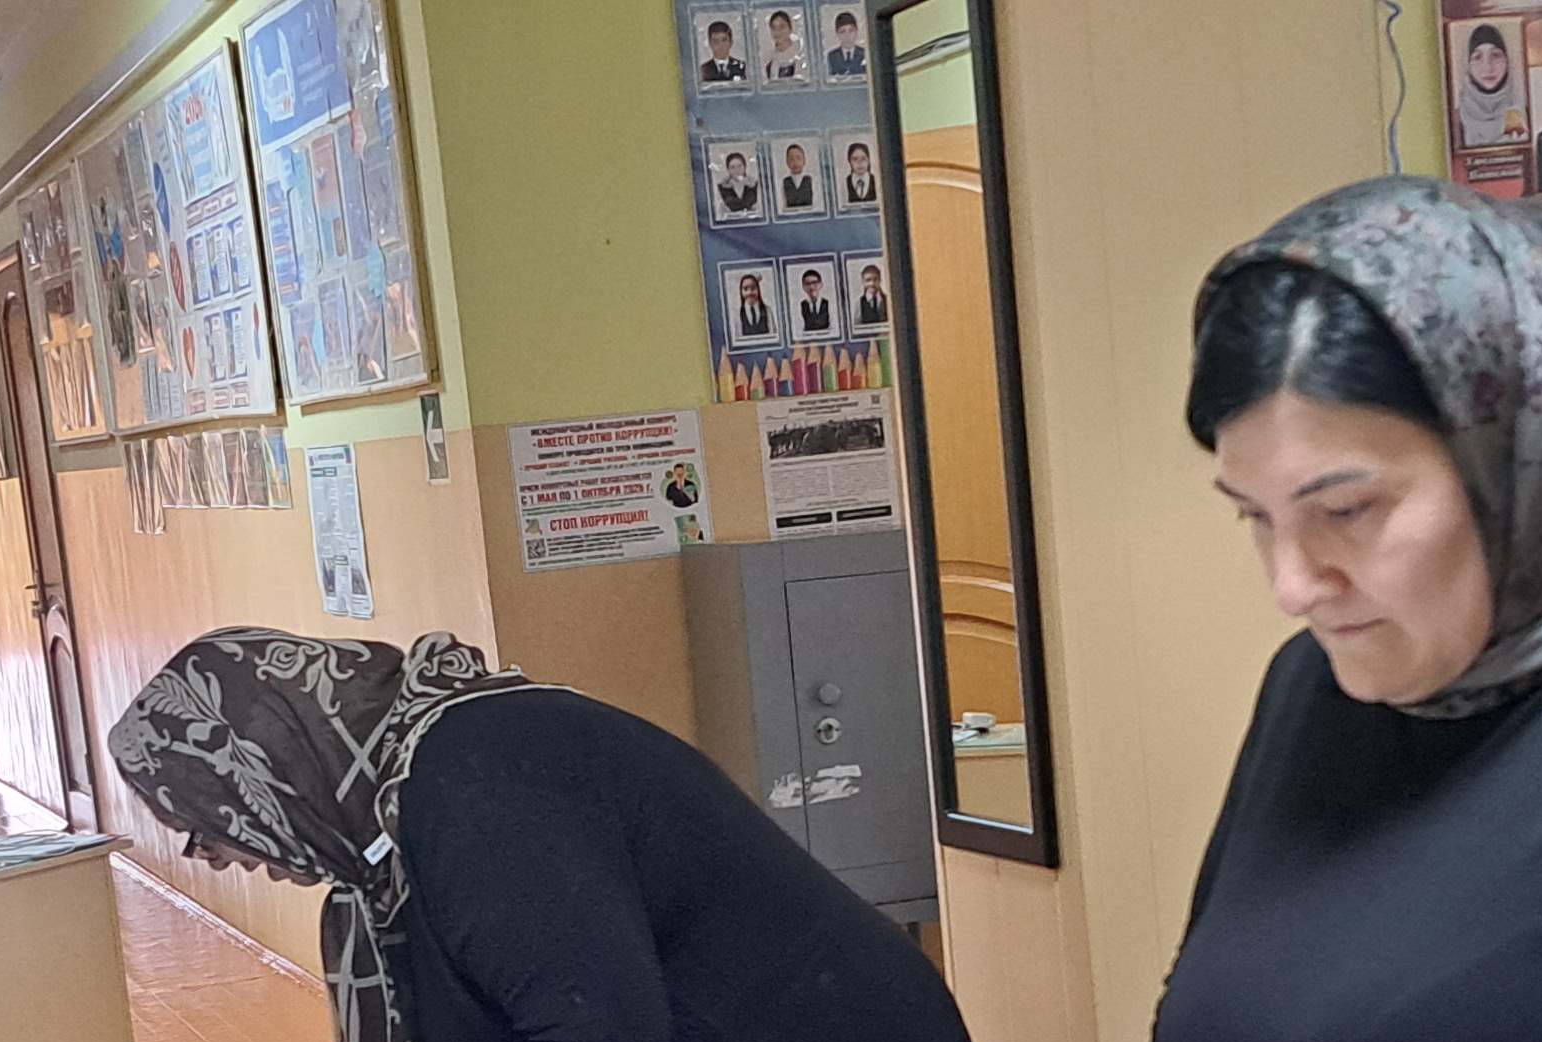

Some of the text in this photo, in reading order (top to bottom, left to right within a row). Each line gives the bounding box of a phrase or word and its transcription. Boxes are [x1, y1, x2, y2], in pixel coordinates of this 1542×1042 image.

[577, 431, 613, 445] ПРОТИВ
[521, 496, 527, 506] С
[537, 492, 558, 503] МАЯ
[559, 491, 571, 501] ПО
[581, 486, 621, 499] ОКТЯБРЯ
[549, 510, 649, 532] СТОП КОРРУПЦИЯ!
